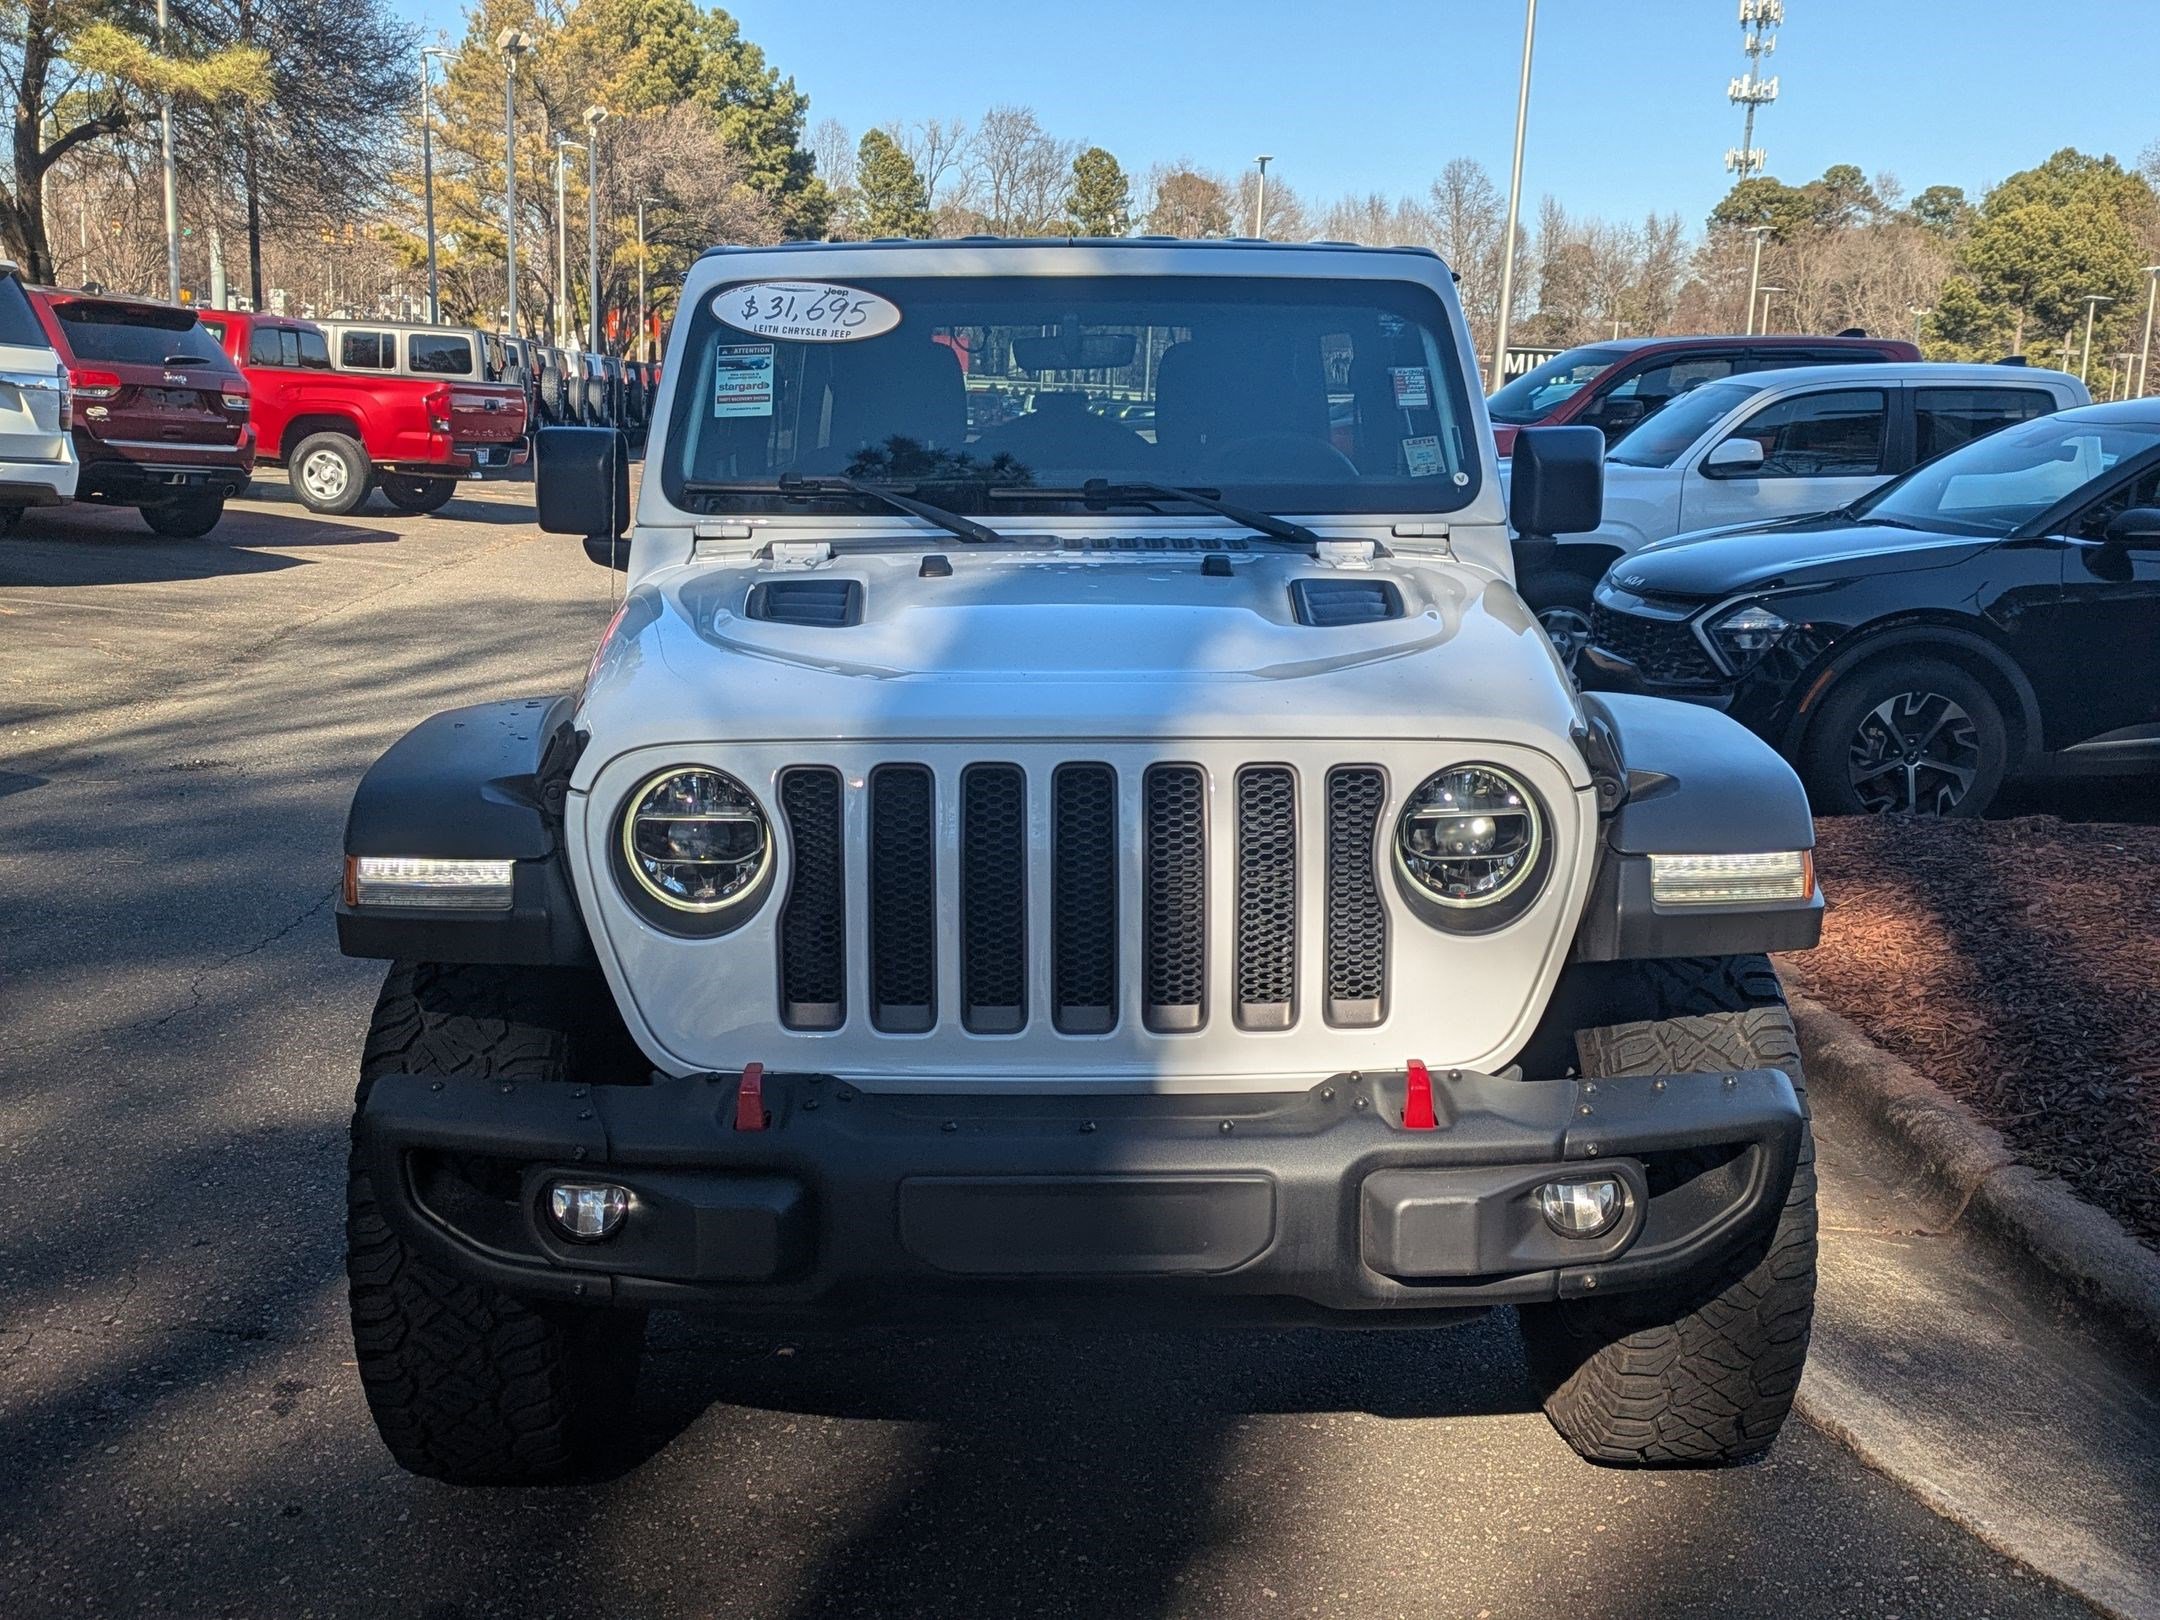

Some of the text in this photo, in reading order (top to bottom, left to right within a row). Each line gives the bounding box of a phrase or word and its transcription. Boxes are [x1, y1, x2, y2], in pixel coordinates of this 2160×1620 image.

[824, 287, 849, 297] Jeep
[753, 324, 852, 339] LEITH CHRYSLER JEEP
[733, 346, 771, 355] ATTENTION
[163, 371, 188, 384] Jeep
